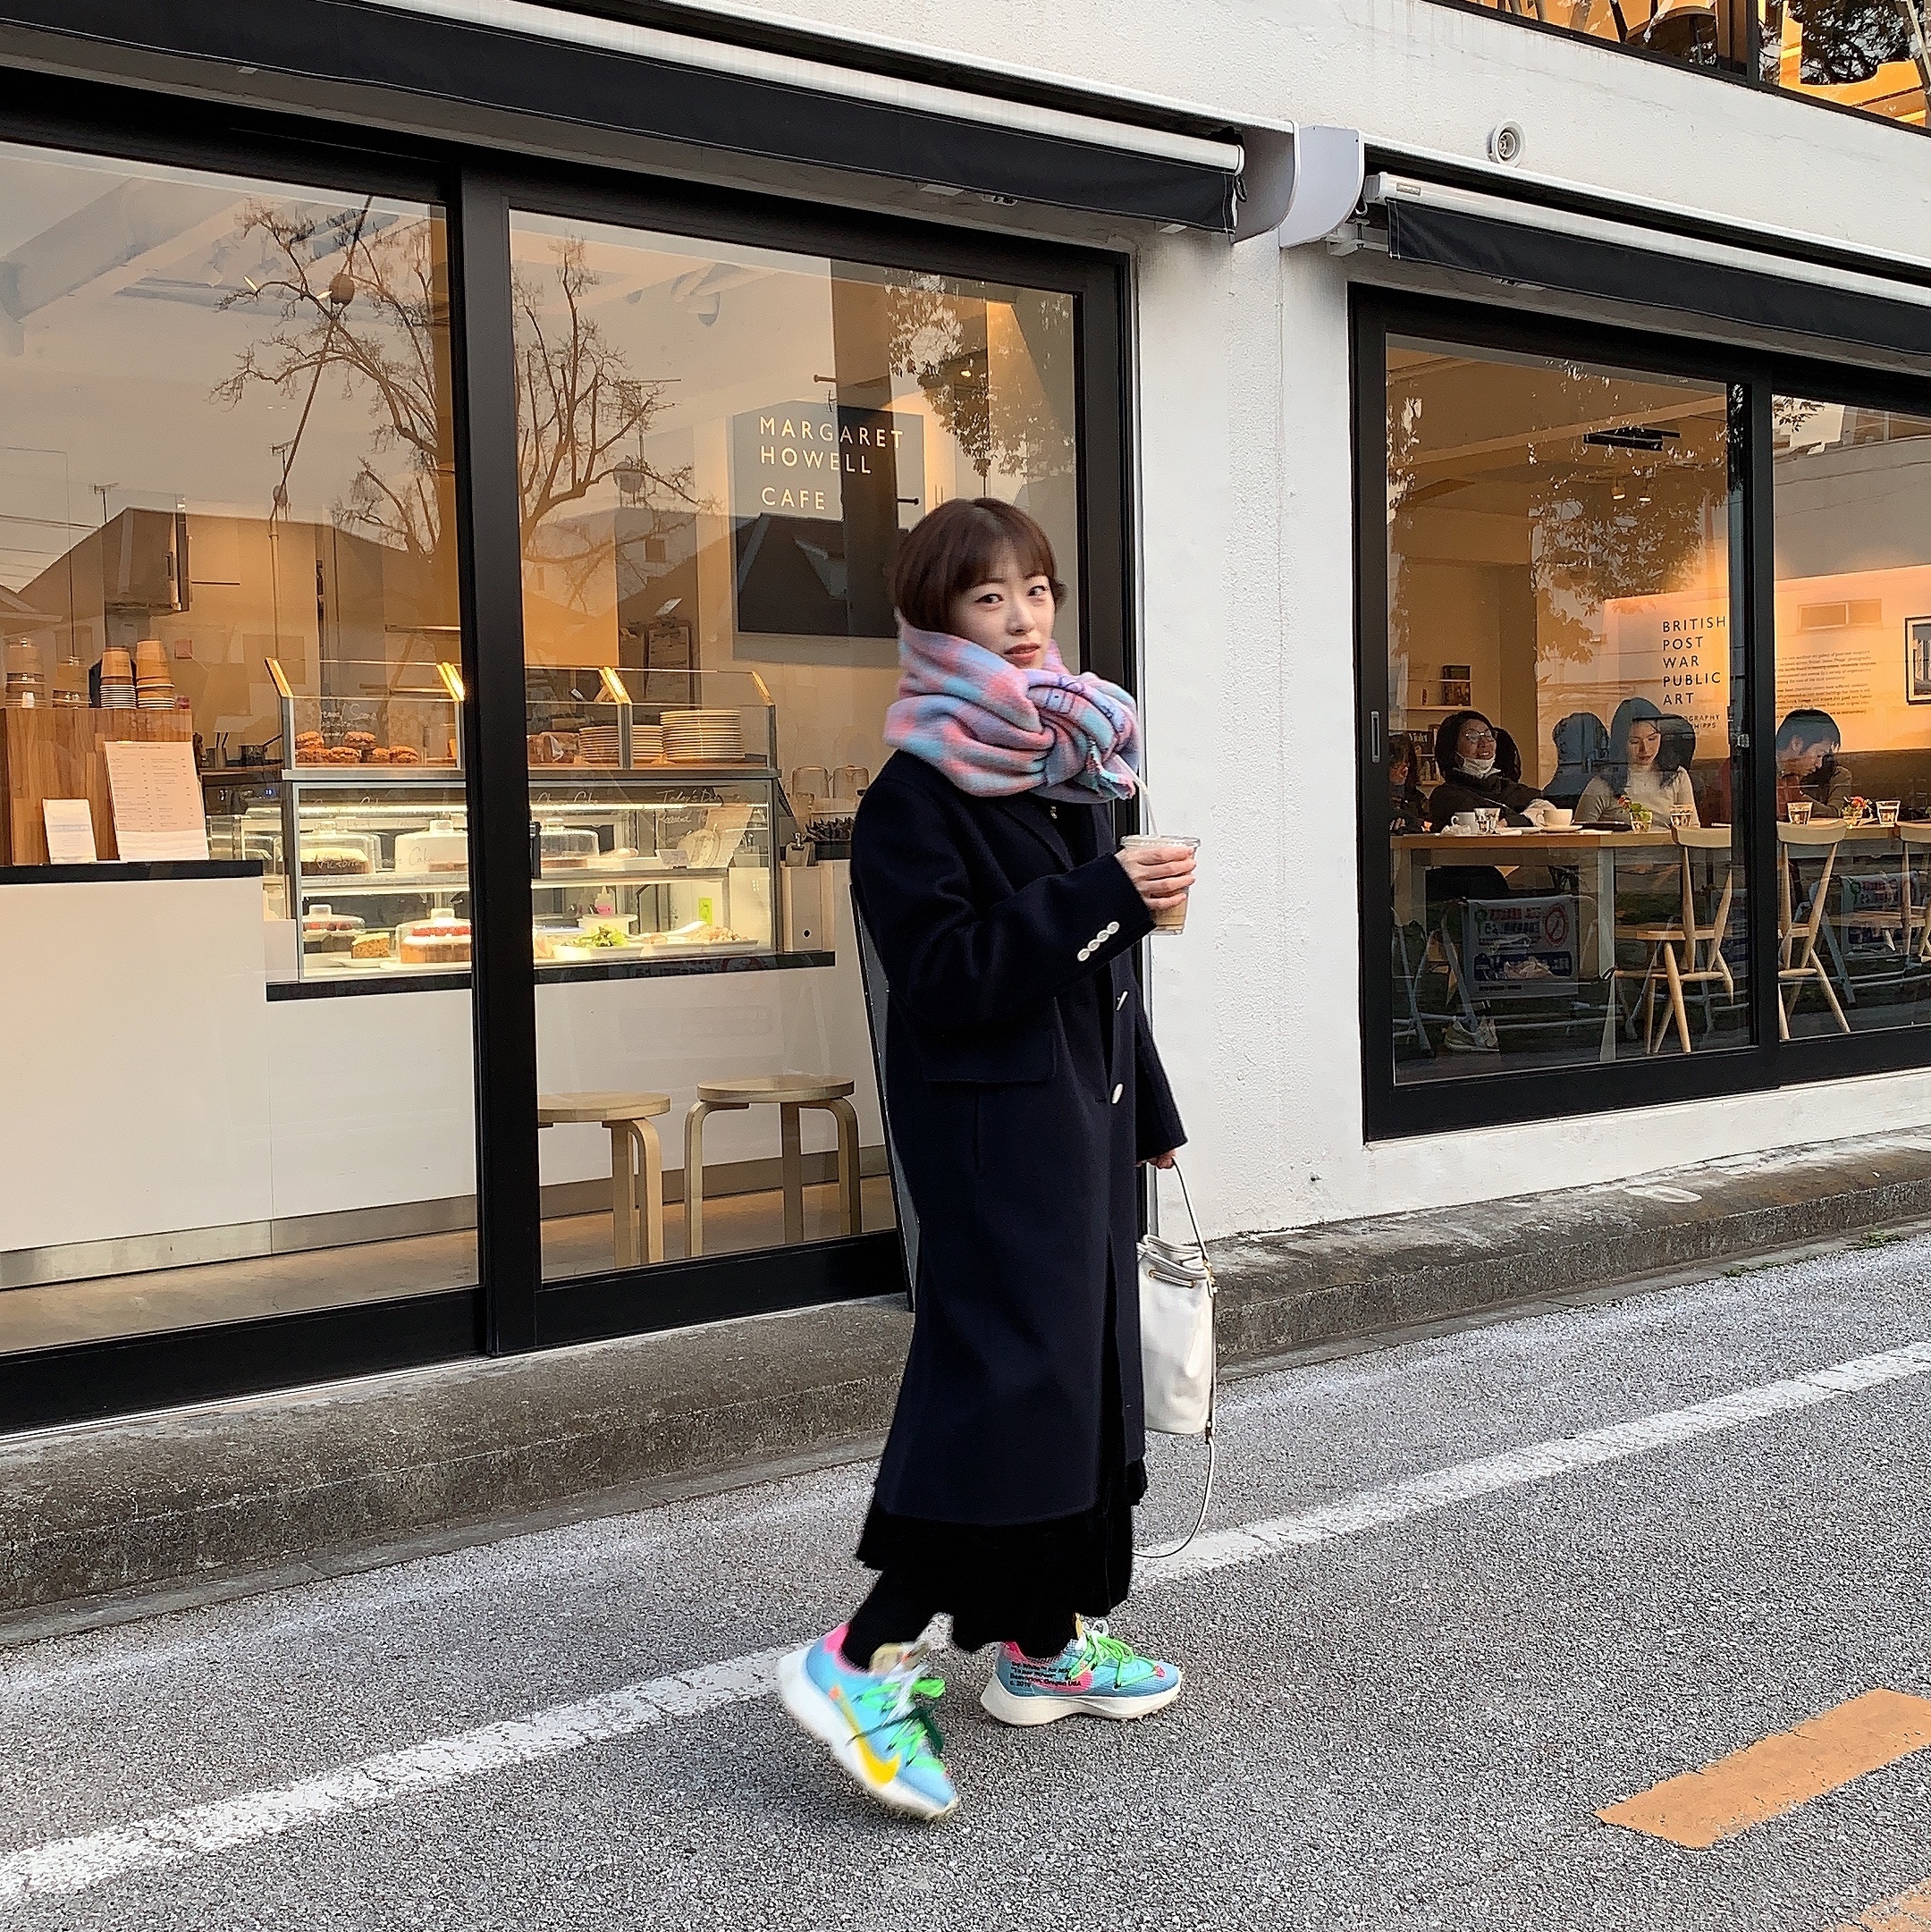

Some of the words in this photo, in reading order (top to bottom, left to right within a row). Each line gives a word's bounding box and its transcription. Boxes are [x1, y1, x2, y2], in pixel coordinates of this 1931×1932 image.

[760, 416, 904, 449] MARGARET
[760, 445, 872, 475] HOWELL
[761, 486, 825, 510] CAFE
[1663, 616, 1725, 633] BRITISH
[1663, 636, 1703, 651] POST
[1663, 655, 1699, 669] WAR
[1663, 672, 1721, 688] PUBLIC
[1663, 693, 1694, 705] ART
